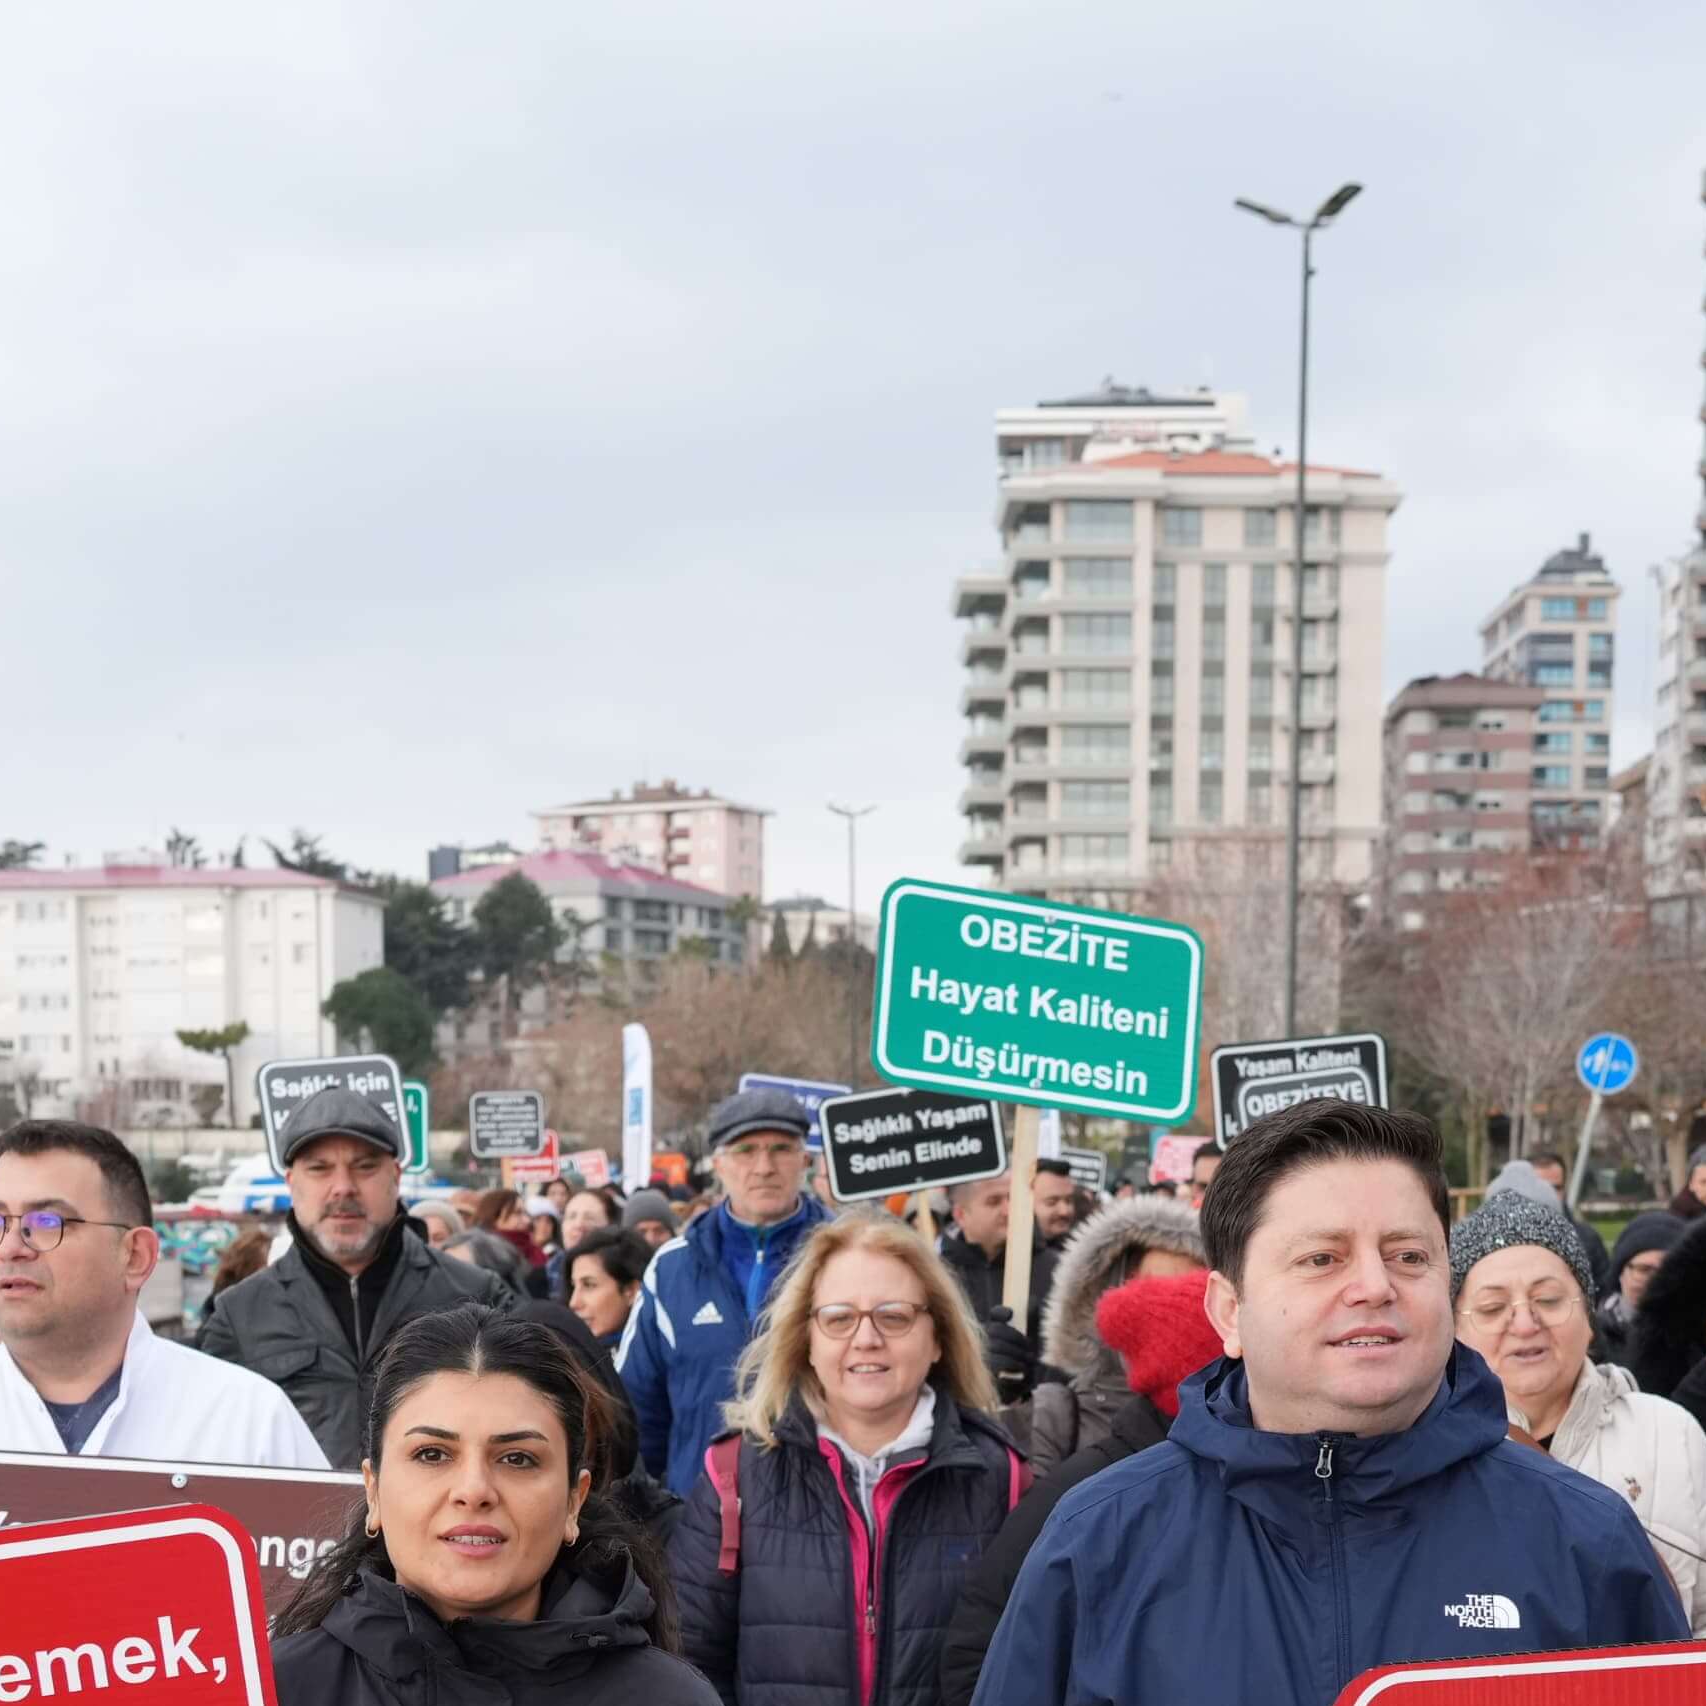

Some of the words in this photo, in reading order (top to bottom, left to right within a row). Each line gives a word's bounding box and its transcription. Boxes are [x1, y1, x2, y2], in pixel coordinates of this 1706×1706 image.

[961, 914, 1129, 972] OBEZİTE
[911, 967, 1020, 1016] Hayat
[1030, 987, 1169, 1039] Kaliteni
[922, 1030, 1148, 1097] Düşürmesin
[1235, 1056, 1293, 1078] Yaşam
[1295, 1047, 1361, 1072] Kaliteni
[347, 1071, 390, 1096] için
[834, 1114, 913, 1144] Sağlıklı
[914, 1103, 989, 1130] Yaşam
[849, 1149, 911, 1174] Senin
[915, 1136, 983, 1163] Elinde
[1444, 1605, 1494, 1617] NORTH
[1465, 1594, 1493, 1606] THE
[1459, 1616, 1494, 1628] FACE
